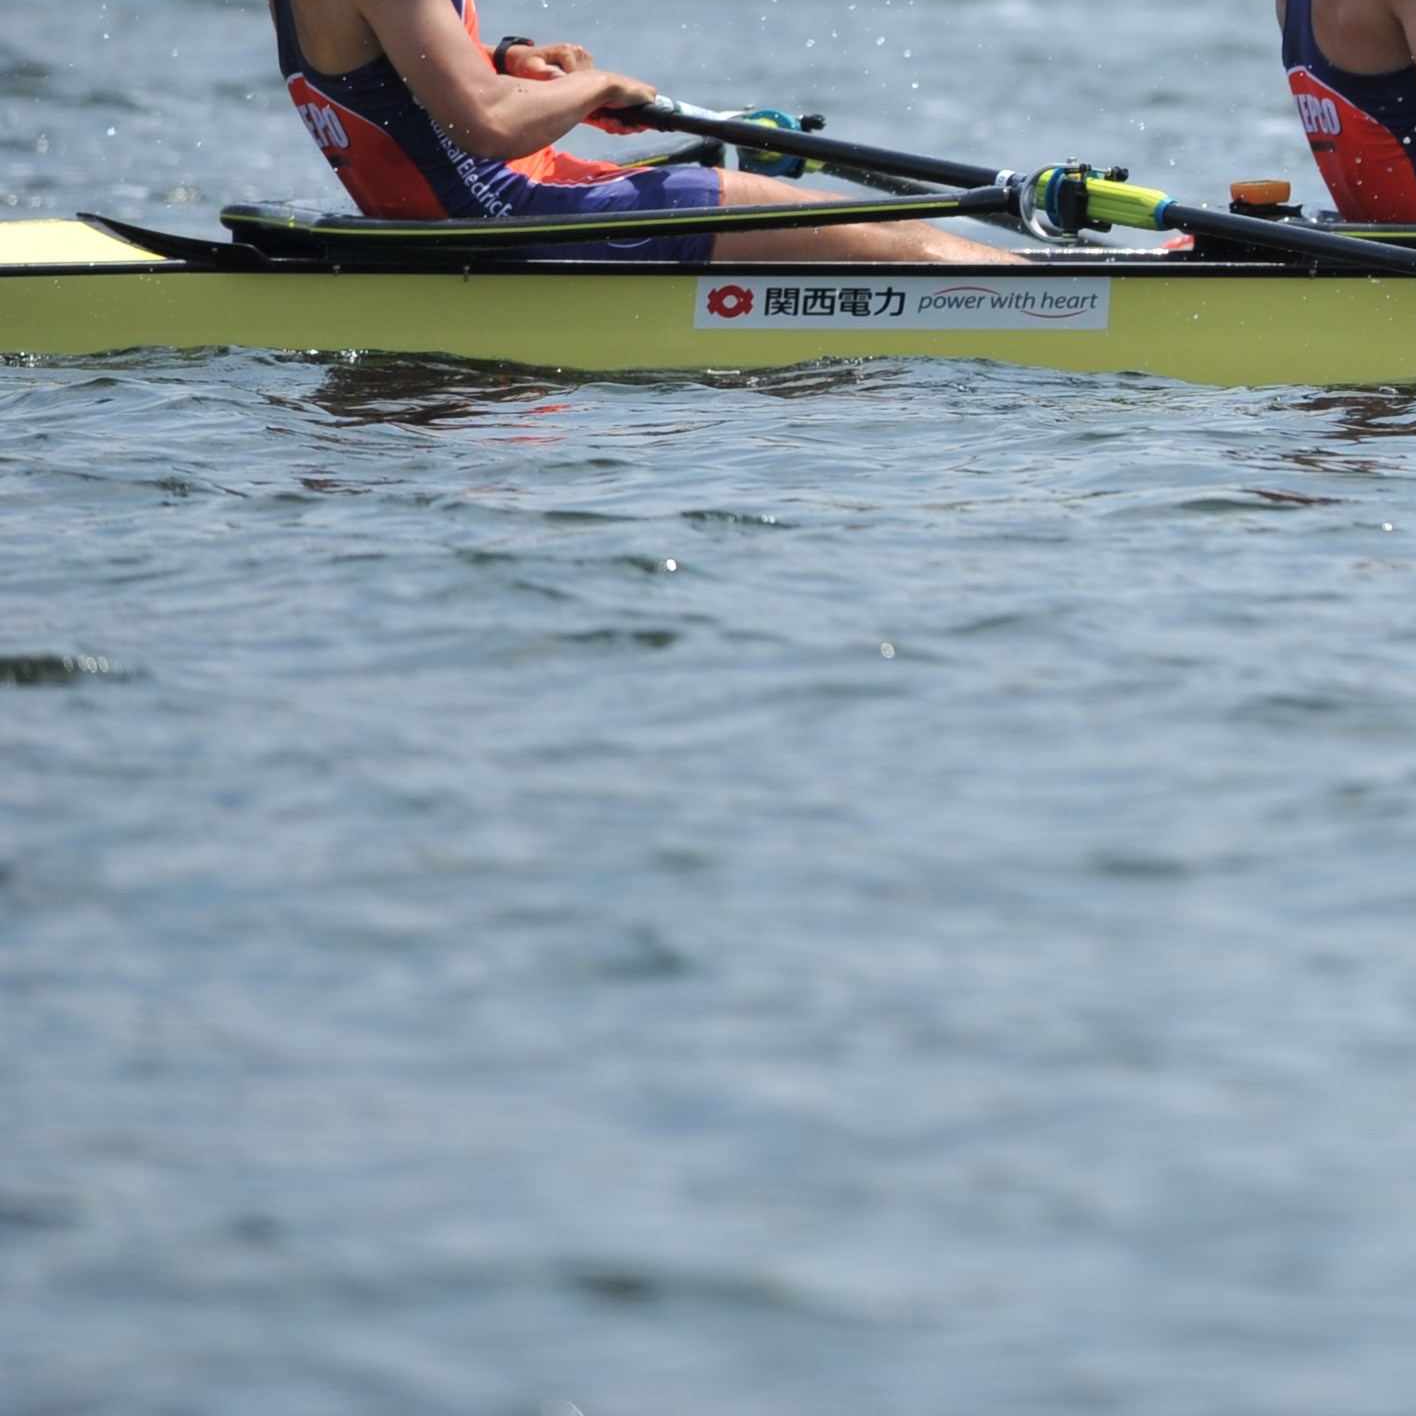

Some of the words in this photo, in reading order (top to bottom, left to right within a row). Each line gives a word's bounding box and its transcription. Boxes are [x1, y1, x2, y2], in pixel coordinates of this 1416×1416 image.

[764, 287, 905, 317] 関西電力
[918, 293, 986, 313] power
[990, 290, 1036, 310] with
[1040, 290, 1098, 310] heart
